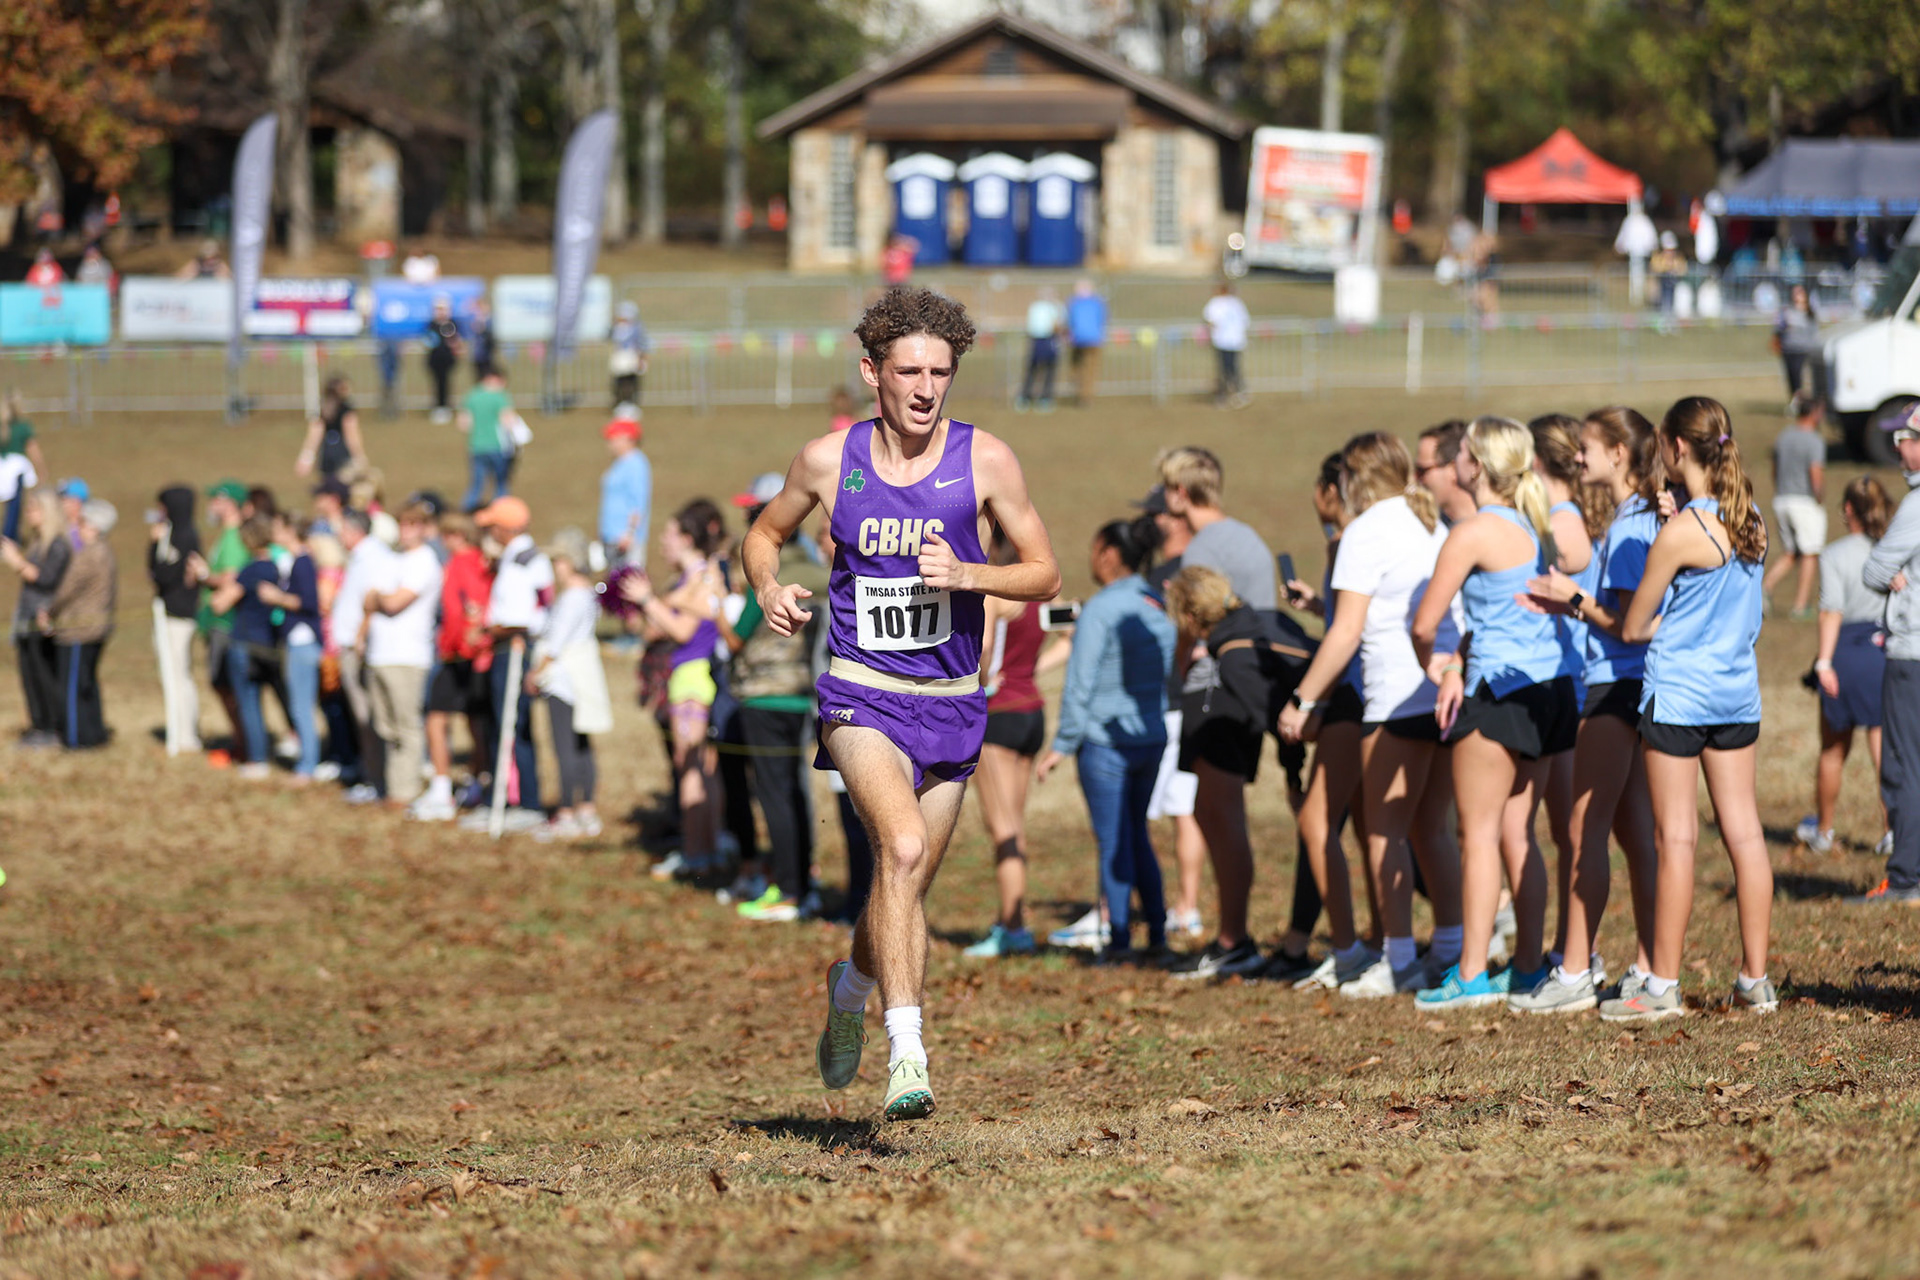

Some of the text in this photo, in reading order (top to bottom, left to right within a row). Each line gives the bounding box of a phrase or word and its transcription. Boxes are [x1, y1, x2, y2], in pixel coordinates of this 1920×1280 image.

[865, 586, 897, 597] TMSAA
[898, 585, 926, 597] STATE
[867, 602, 939, 639] 1077
